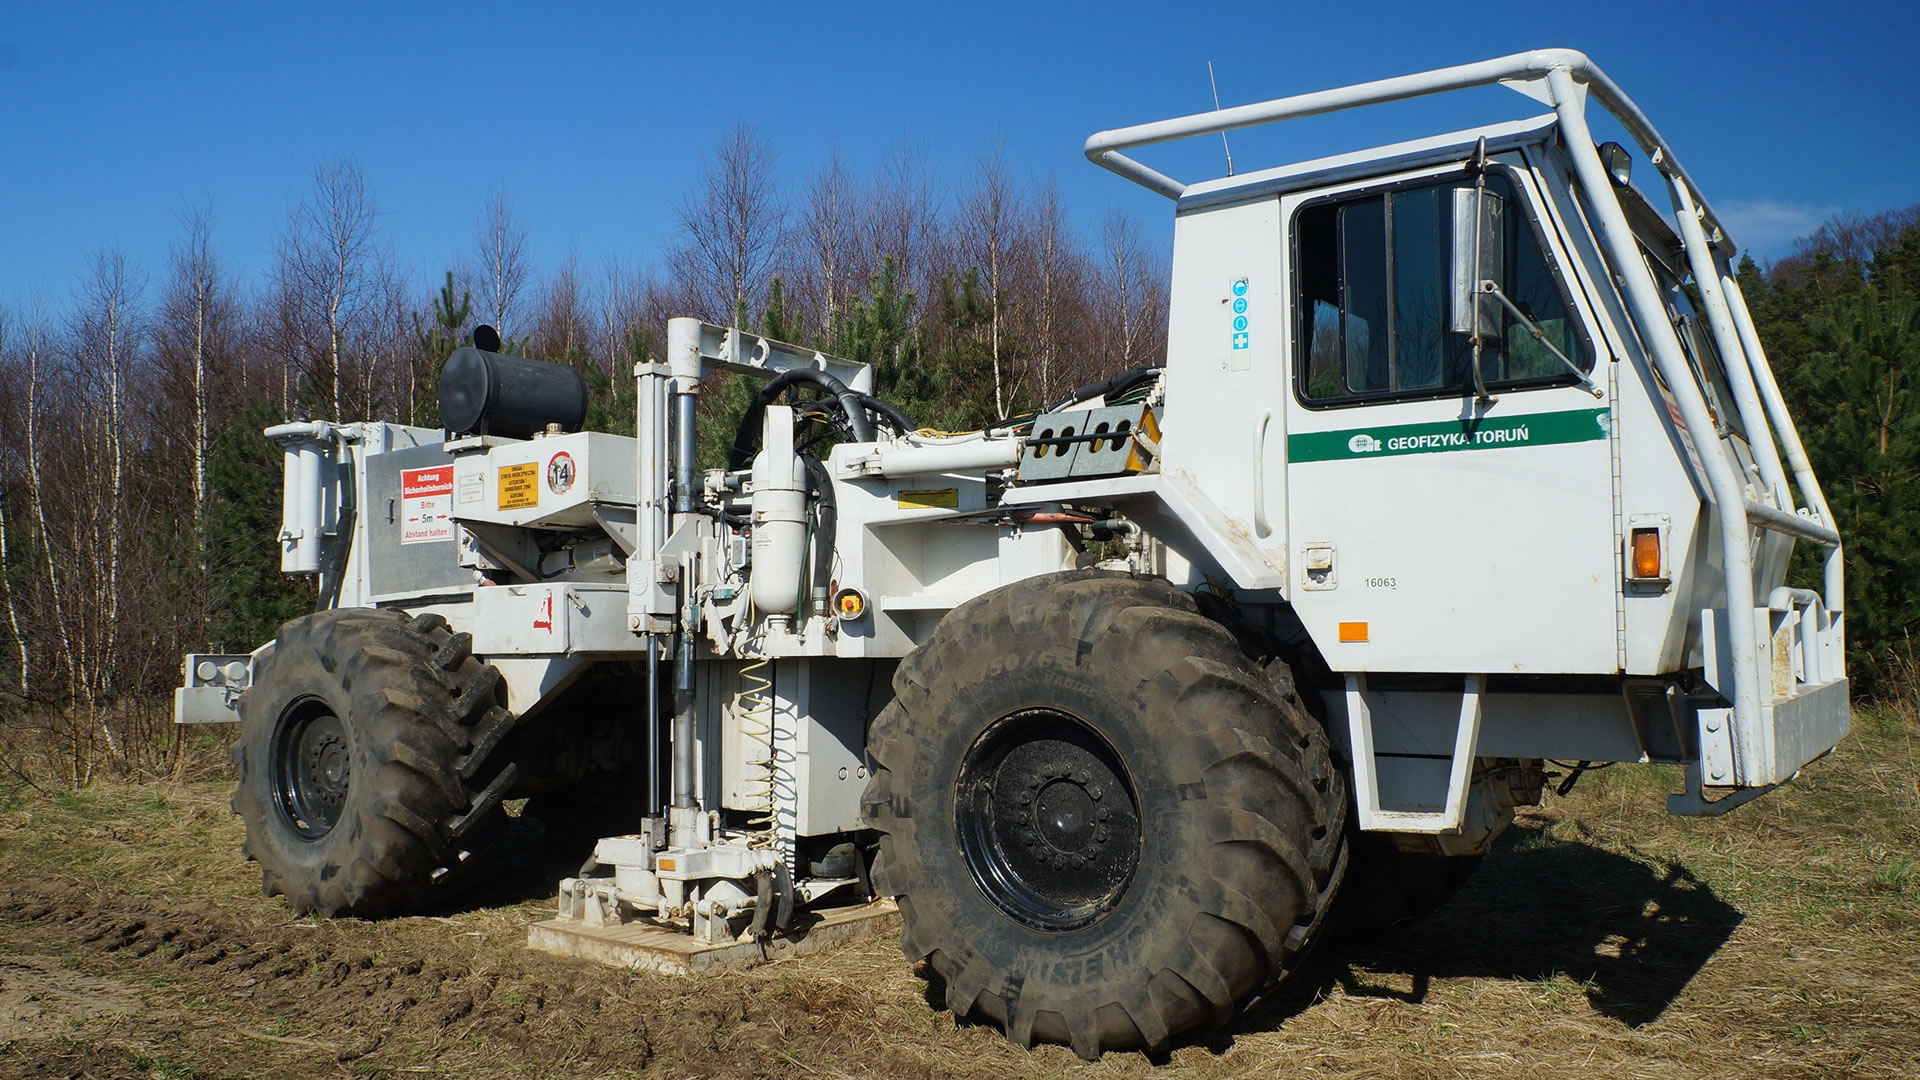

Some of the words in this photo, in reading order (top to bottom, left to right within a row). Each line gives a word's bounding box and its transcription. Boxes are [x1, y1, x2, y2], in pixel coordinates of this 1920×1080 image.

[1387, 432, 1470, 450] GEOFIZYKA
[1475, 424, 1530, 444] TORUŃ
[417, 474, 439, 482] Achtung
[553, 463, 569, 485] 14
[404, 482, 453, 494] Sicherheitsbereich
[420, 501, 436, 509] Bitte
[421, 513, 434, 523] 5m
[405, 529, 428, 538] Abstand
[429, 527, 448, 537] halten
[1364, 577, 1396, 588] 16063
